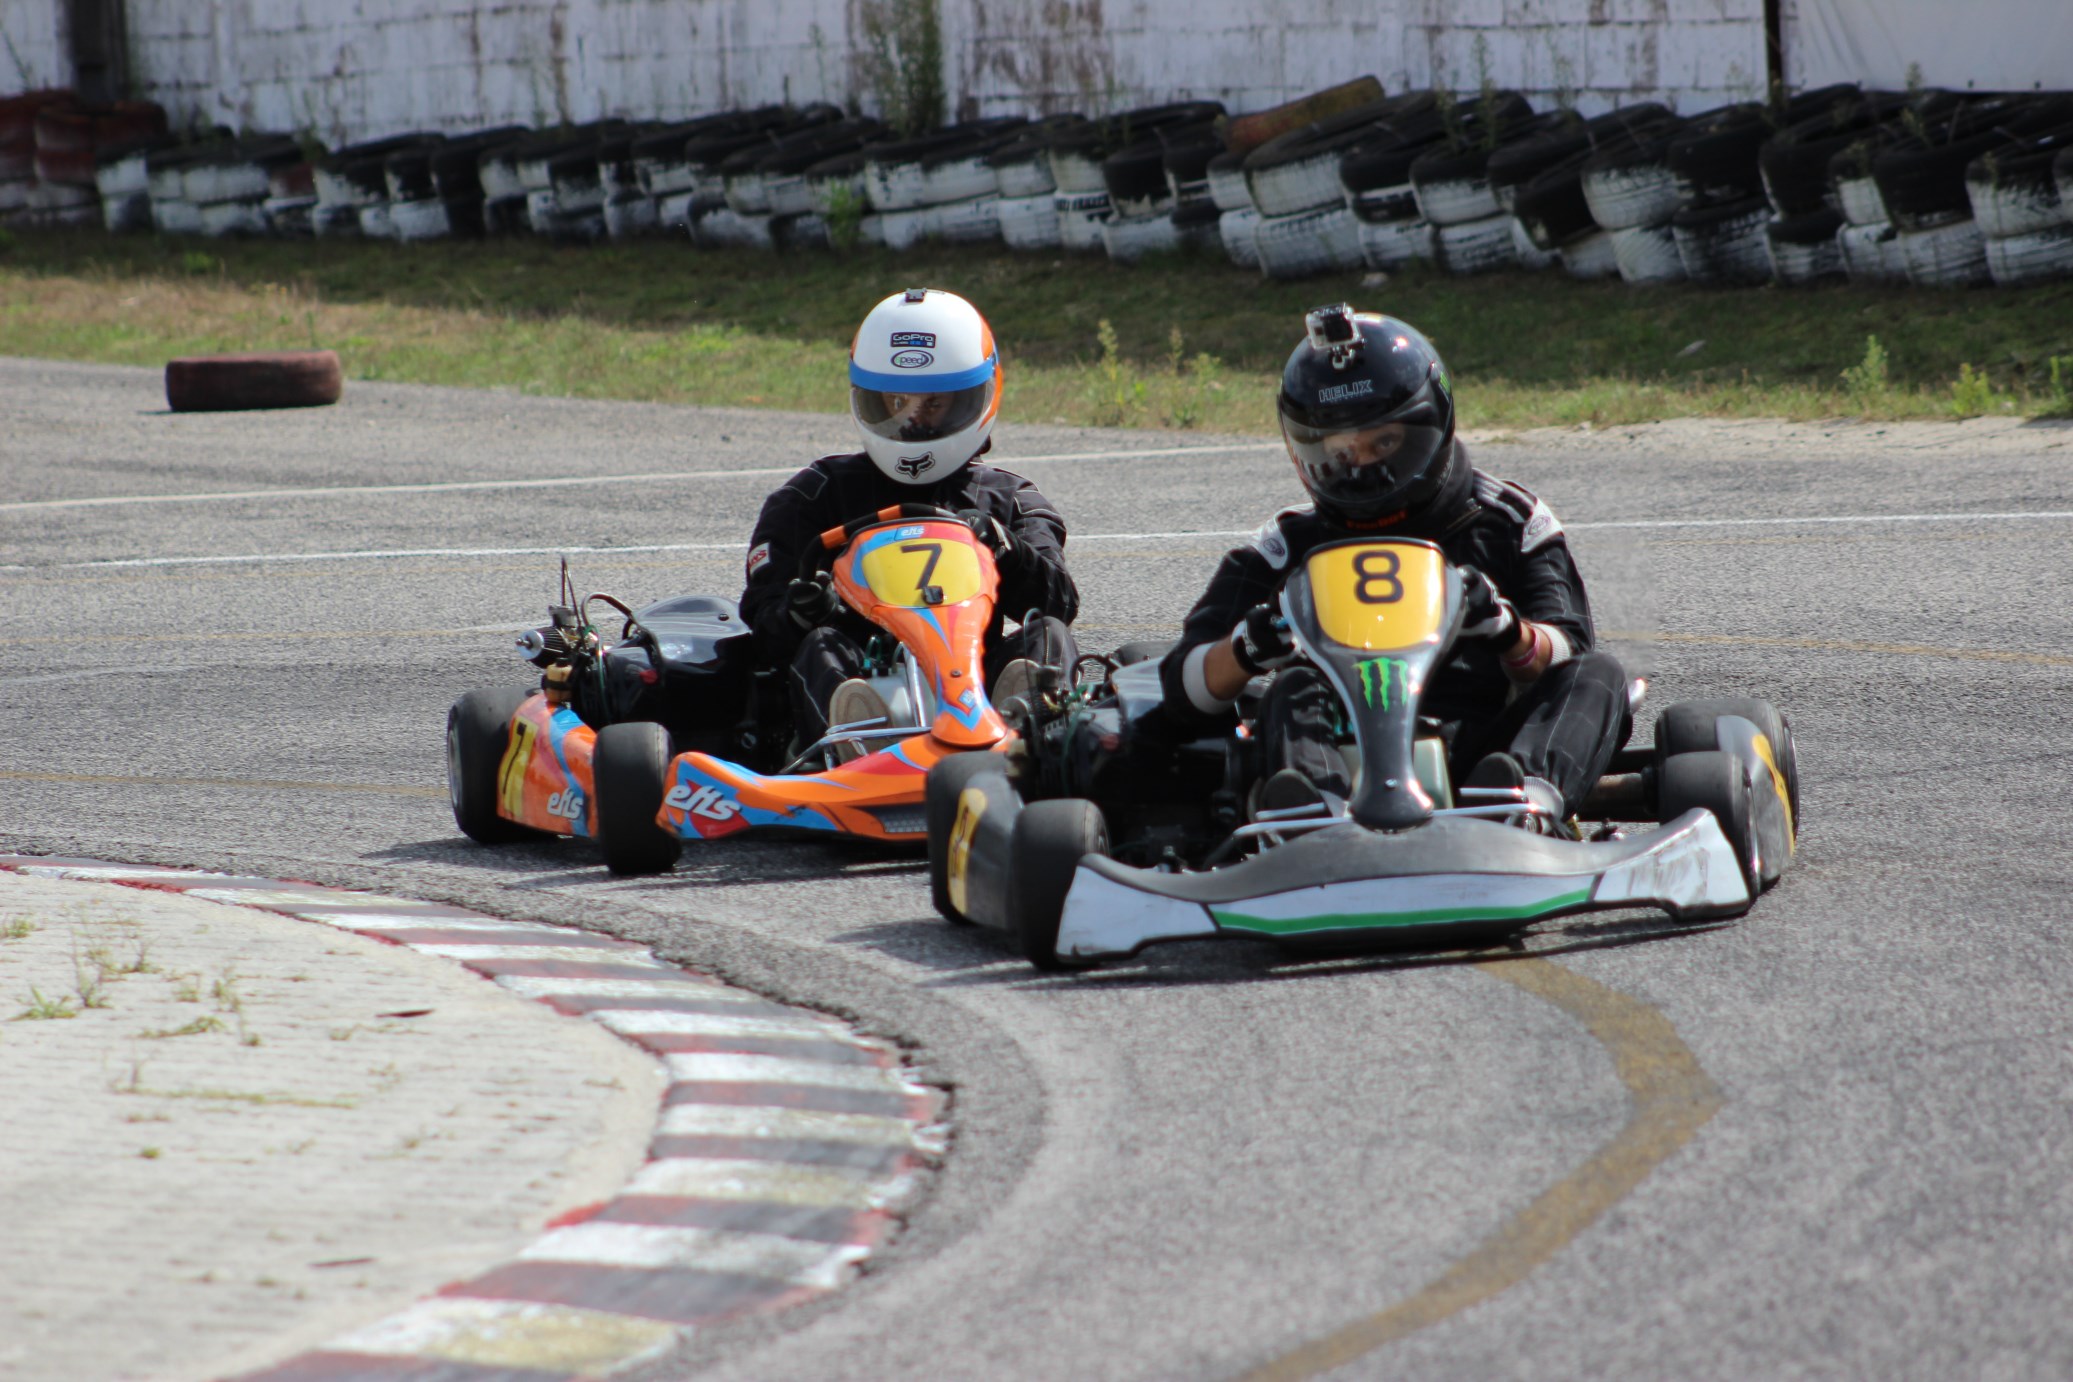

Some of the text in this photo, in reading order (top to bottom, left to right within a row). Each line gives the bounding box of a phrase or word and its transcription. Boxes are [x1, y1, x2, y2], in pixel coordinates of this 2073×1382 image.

[892, 333, 934, 342] GoPro
[1318, 379, 1373, 403] HELIX
[900, 543, 943, 590] 7
[1352, 550, 1404, 604] 8
